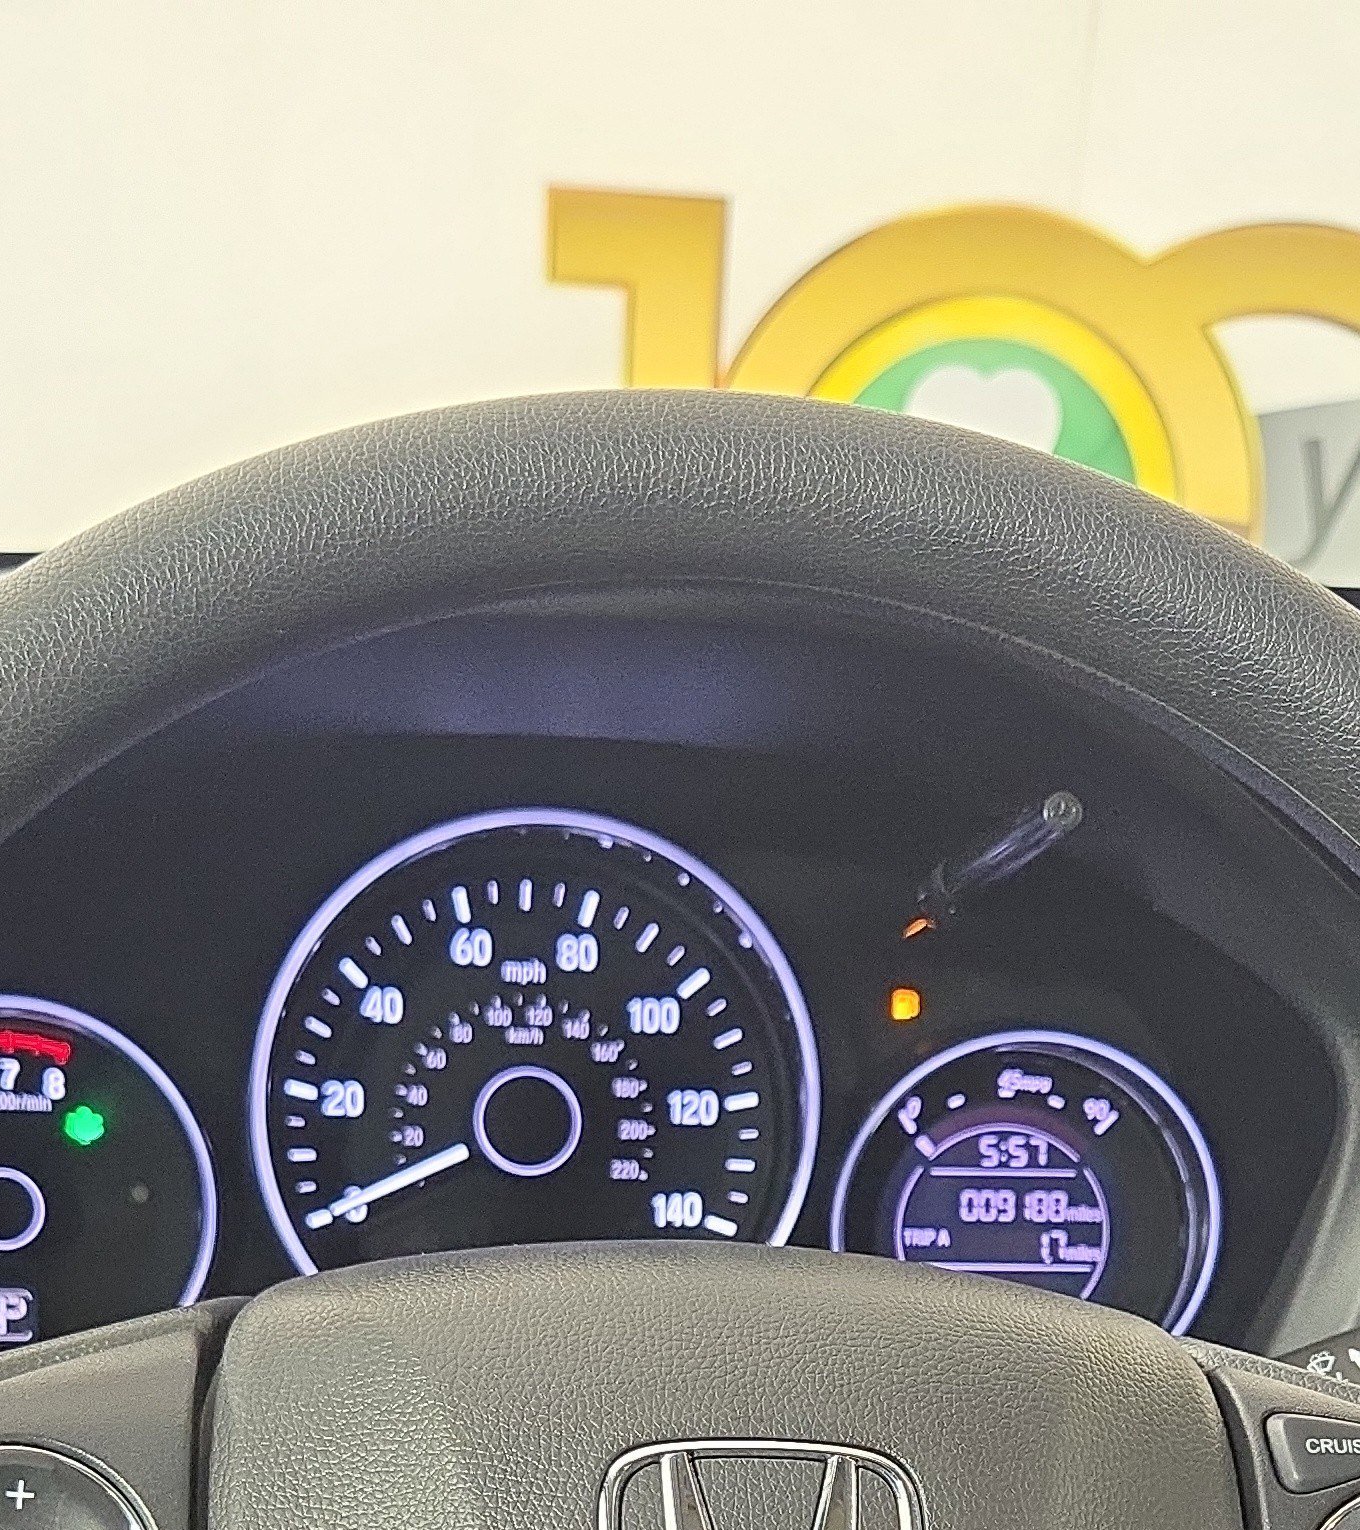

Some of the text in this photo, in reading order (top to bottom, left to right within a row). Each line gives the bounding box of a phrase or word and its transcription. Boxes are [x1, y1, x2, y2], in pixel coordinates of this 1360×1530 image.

[449, 928, 493, 967] 60
[556, 933, 599, 972] 80
[501, 960, 546, 985] mph
[360, 986, 403, 1024] 40
[626, 997, 680, 1035] 100
[42, 1067, 66, 1100] 8
[320, 1081, 365, 1117] 20
[667, 1090, 719, 1127] 120
[978, 1135, 1048, 1167] 5:57
[650, 1192, 703, 1228] 140
